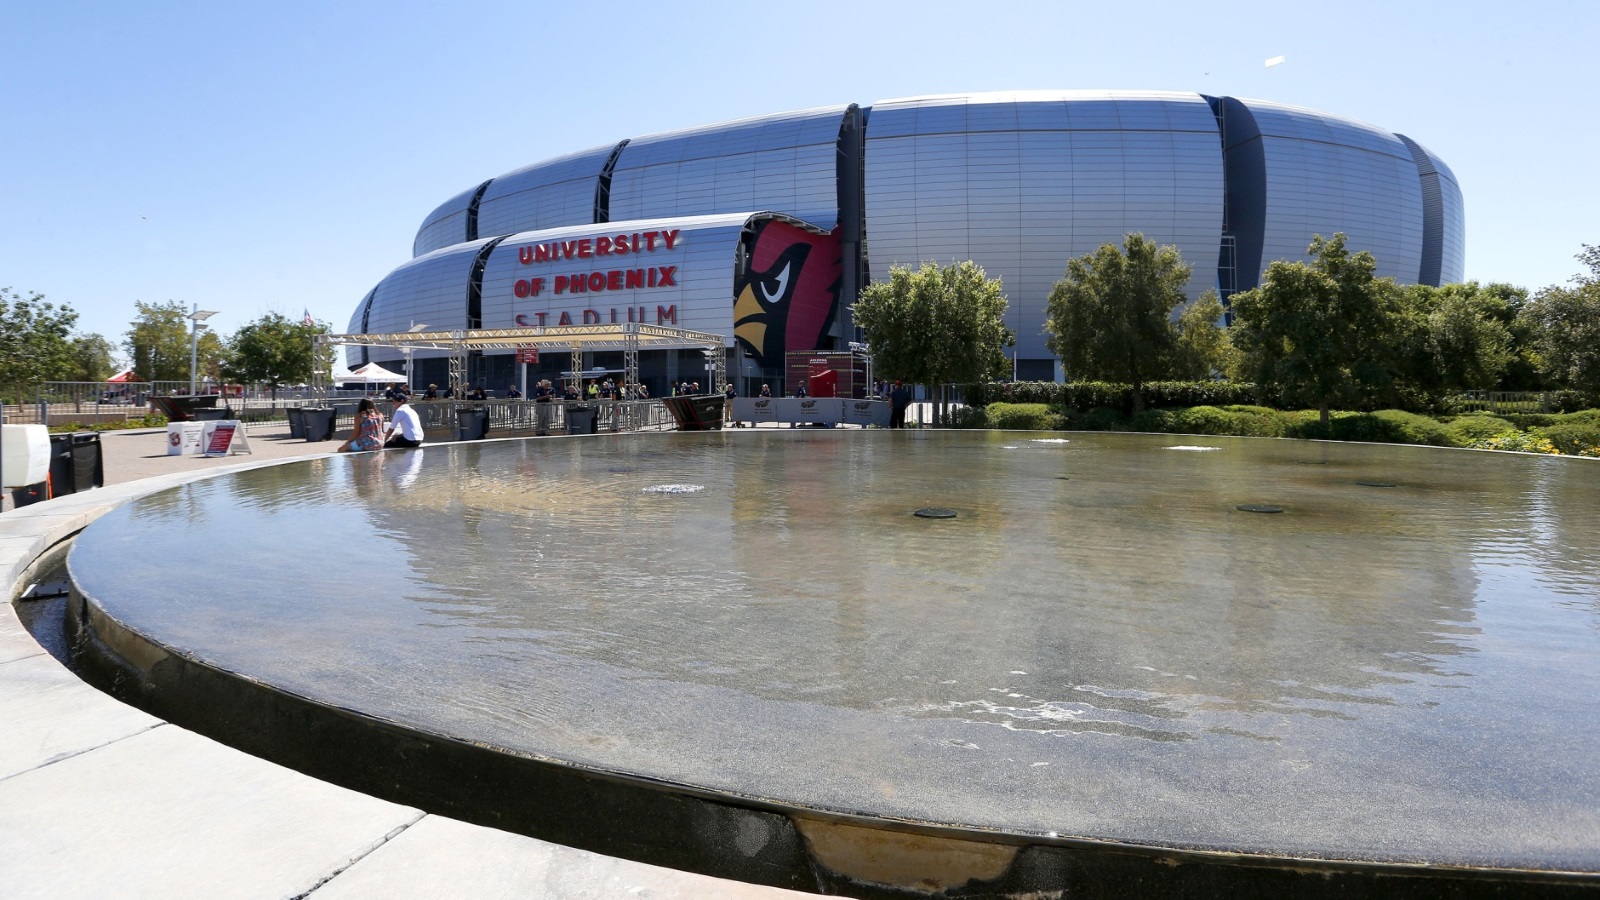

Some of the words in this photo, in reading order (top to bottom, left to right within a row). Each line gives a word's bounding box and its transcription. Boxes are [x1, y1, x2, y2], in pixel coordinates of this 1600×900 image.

[519, 229, 680, 264] UNIVERSITY
[514, 278, 544, 298] OF
[554, 266, 678, 295] PHOENIX
[515, 304, 676, 326] STADIUM
